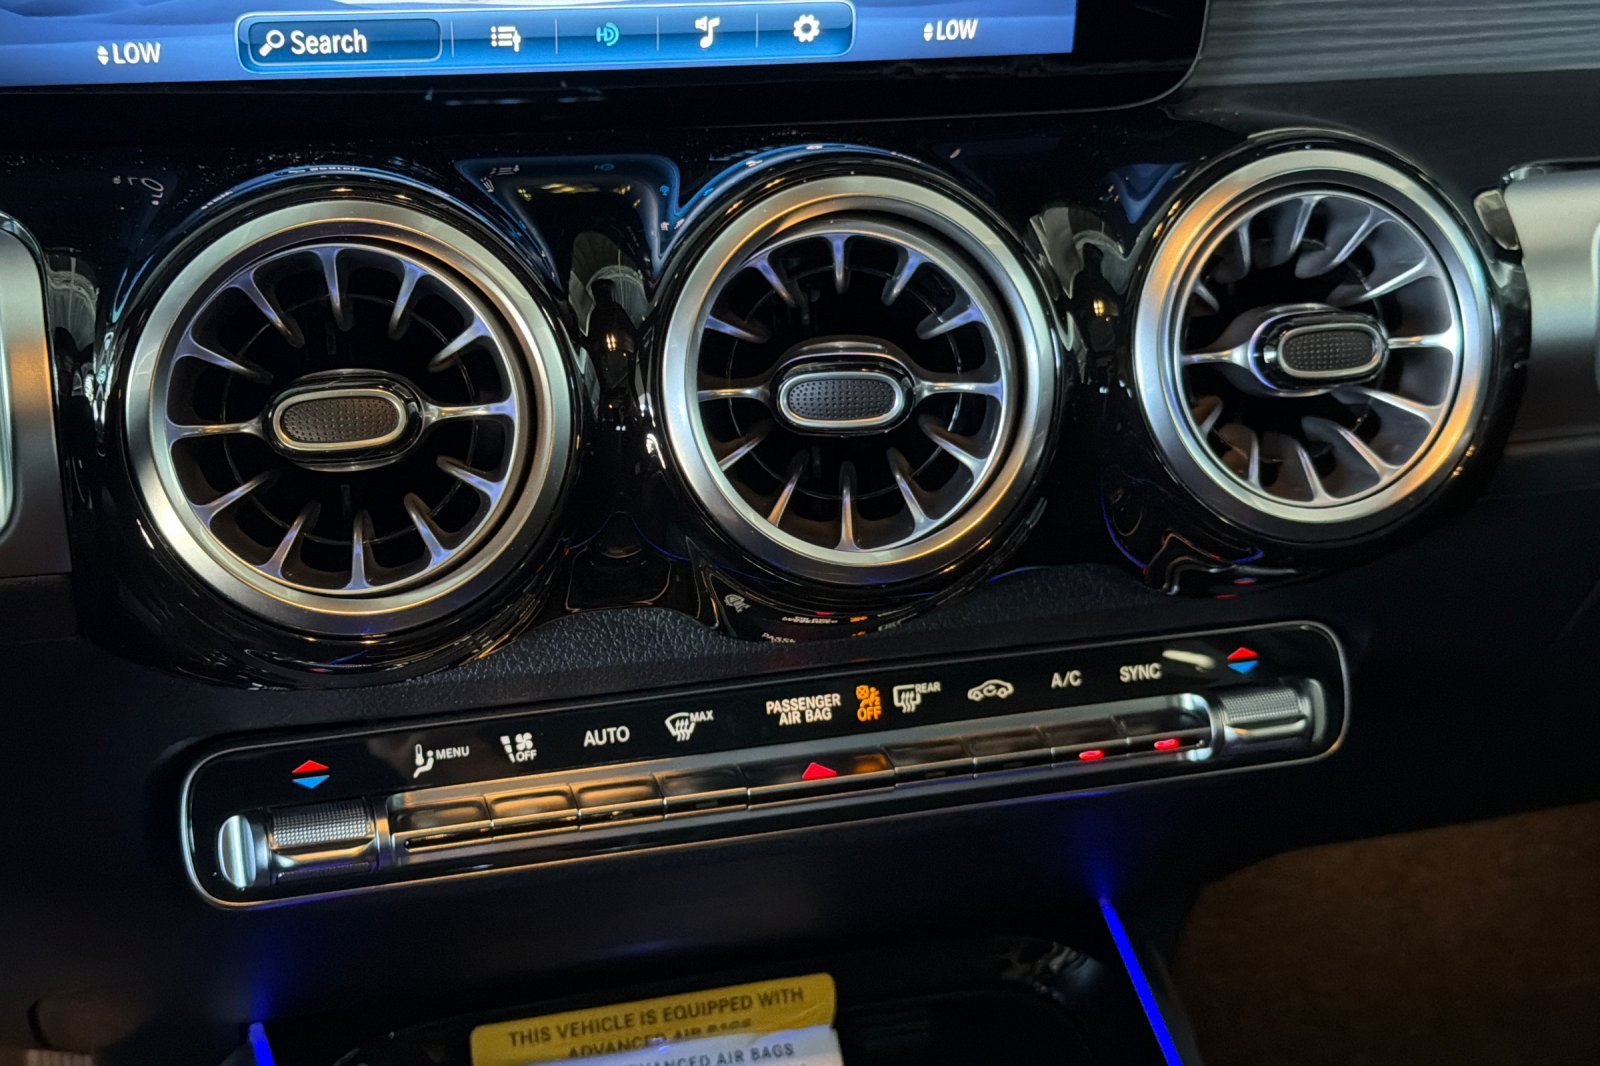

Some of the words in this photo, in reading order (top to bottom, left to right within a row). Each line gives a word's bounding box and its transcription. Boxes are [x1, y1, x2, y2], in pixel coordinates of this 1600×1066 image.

[935, 19, 979, 42] LOW
[290, 29, 367, 55] Search
[112, 42, 161, 65] LOW
[1051, 670, 1082, 689] A/C
[1120, 662, 1162, 683] SYNC
[915, 682, 941, 694] REAR
[766, 693, 841, 715] PASSENGER
[857, 706, 881, 722] OFF
[690, 710, 714, 723] MAX
[779, 711, 801, 726] AIR
[805, 707, 832, 723] BAG
[583, 726, 630, 747] AUTO
[436, 746, 470, 760] MENU
[515, 749, 537, 763] OFF
[508, 1026, 551, 1047] THIS
[556, 1013, 634, 1039] VEHICLE
[640, 1008, 657, 1025] IS
[663, 995, 753, 1023] EQUIPPED
[757, 987, 804, 1007] WITH
[717, 1050, 744, 1065] AIR
[751, 1043, 795, 1061] BAGS
